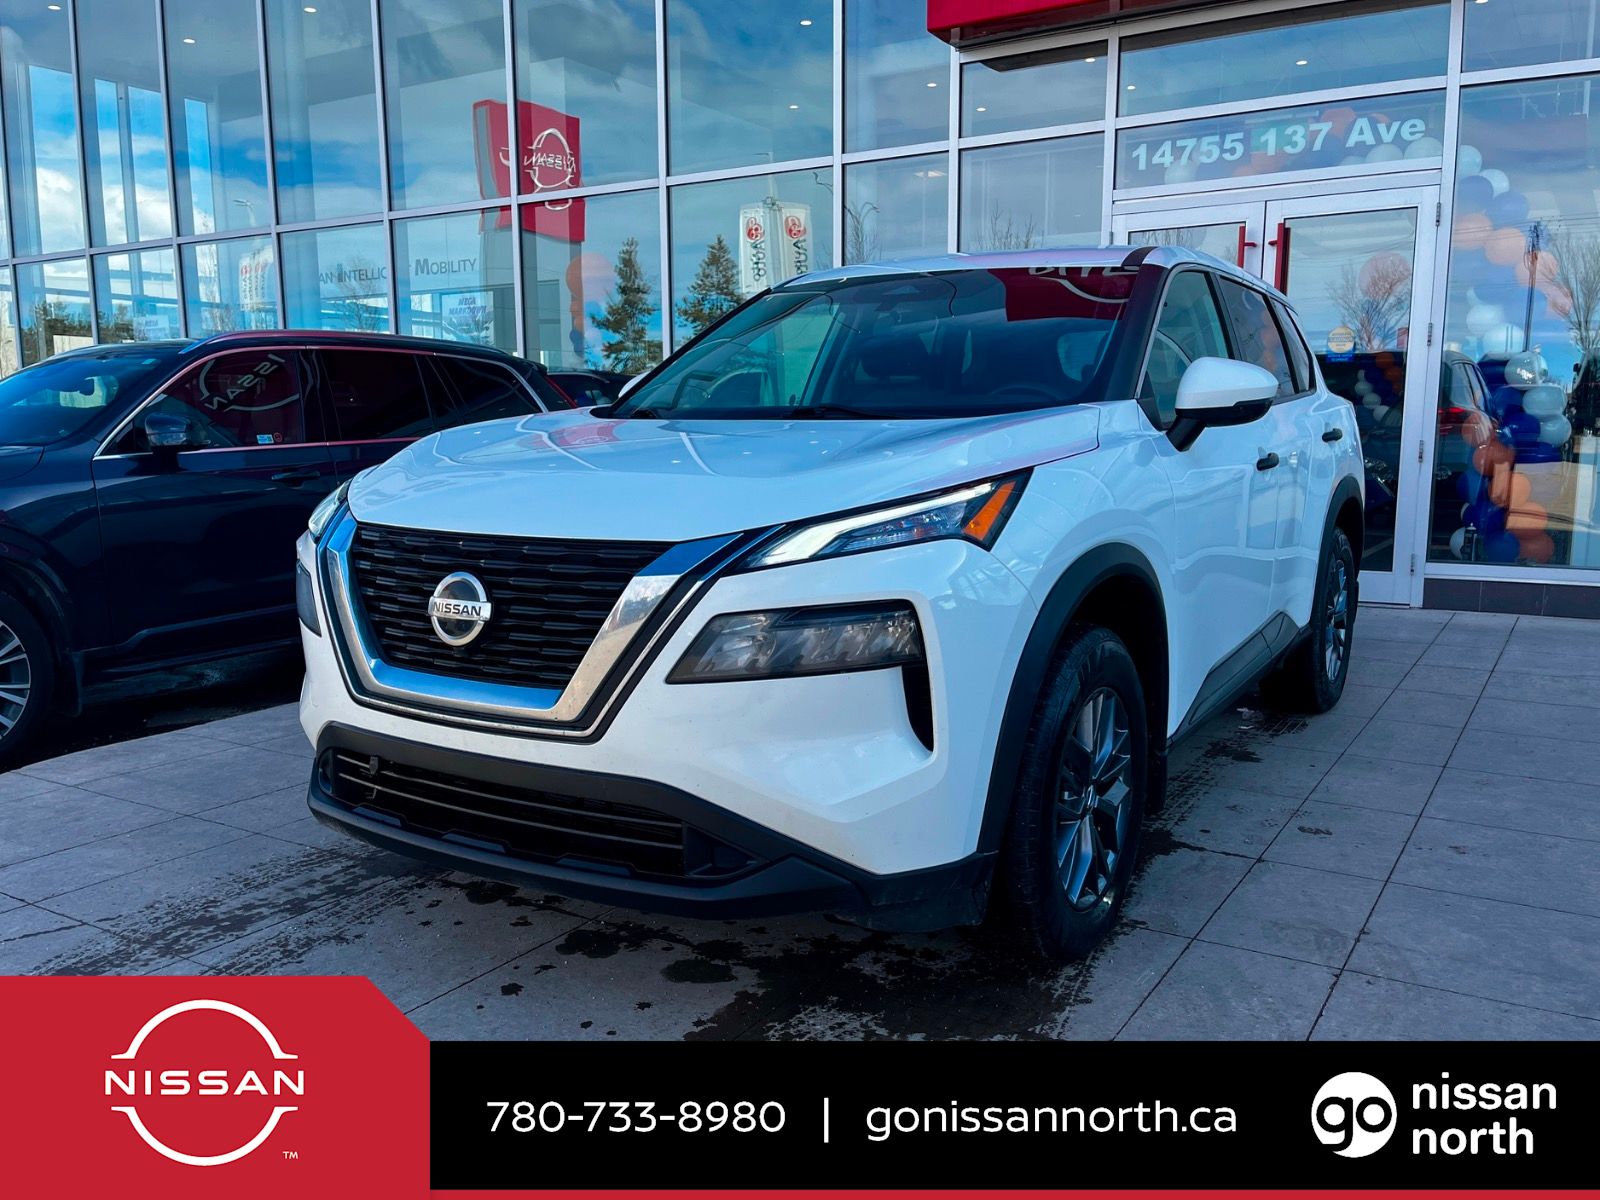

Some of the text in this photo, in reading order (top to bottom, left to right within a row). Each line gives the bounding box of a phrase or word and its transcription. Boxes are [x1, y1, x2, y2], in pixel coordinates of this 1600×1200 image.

[1131, 117, 1426, 170] 14755 137 Ave
[415, 258, 477, 276] MOBILITY
[433, 602, 481, 616] NISSAN
